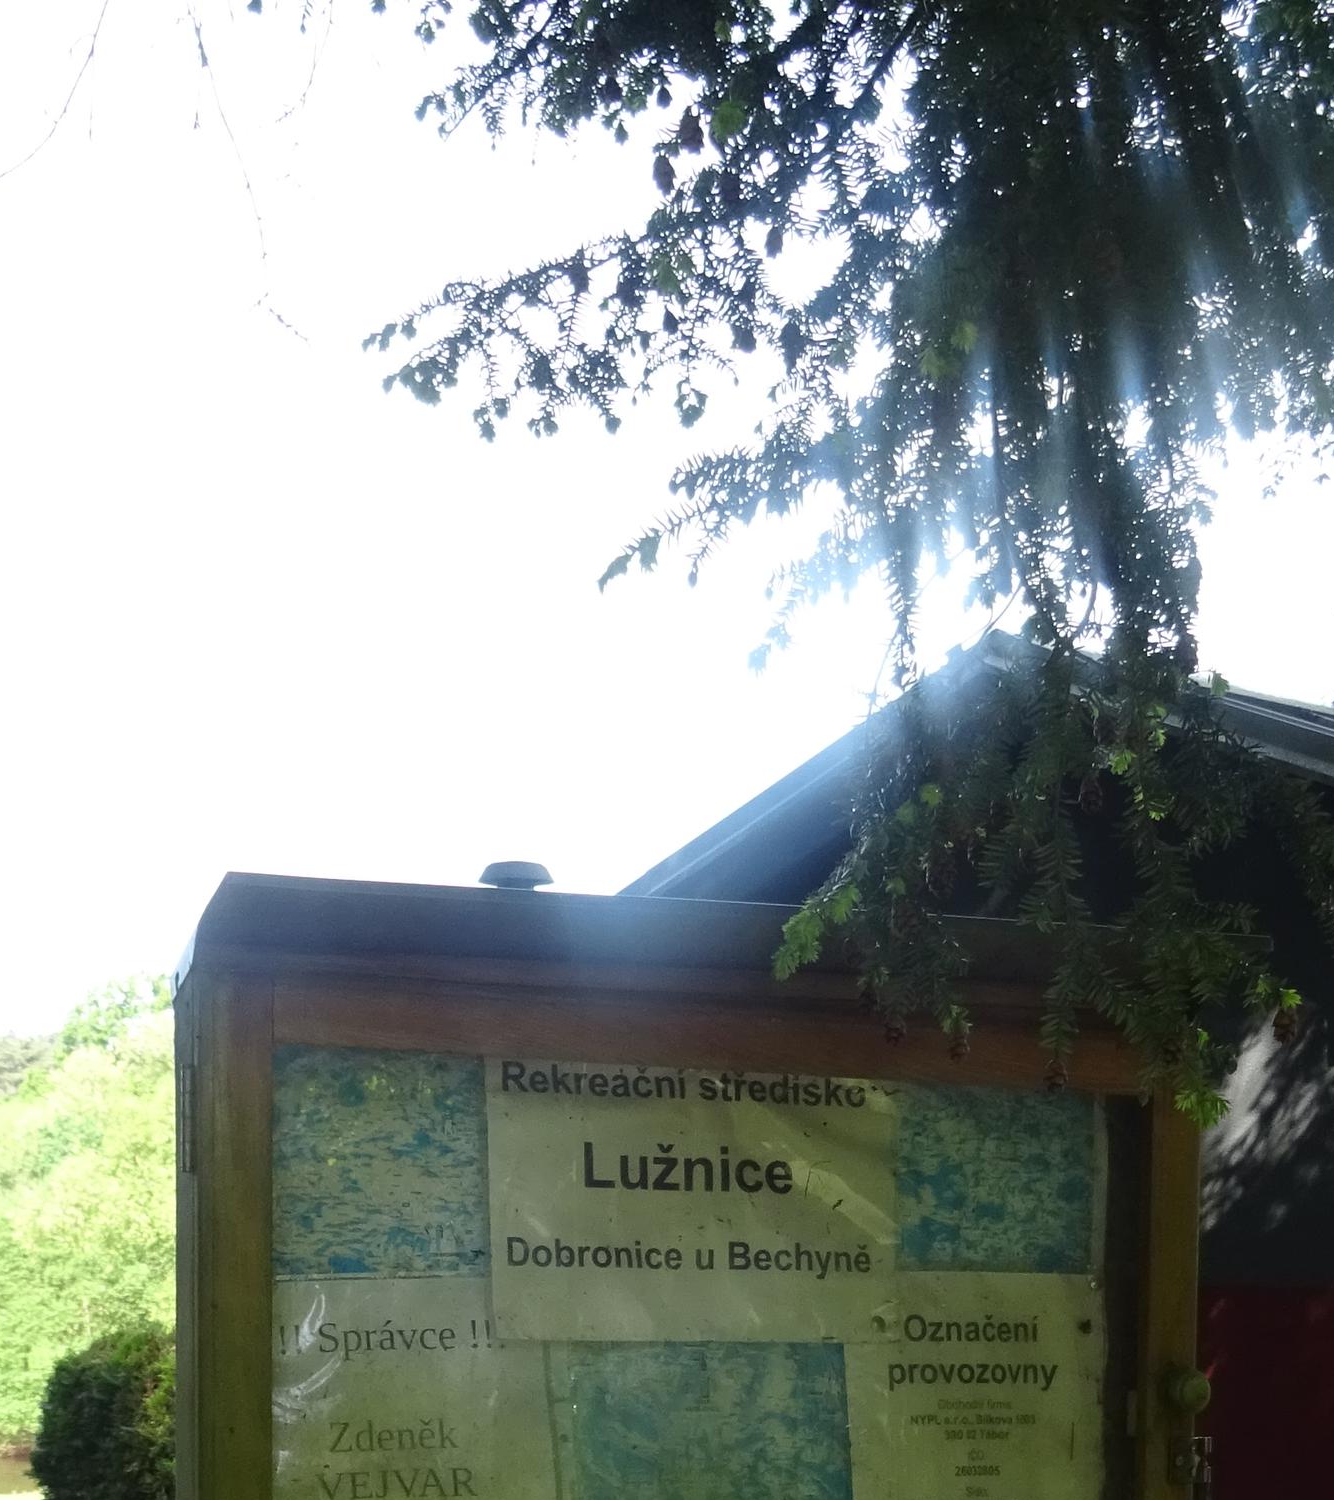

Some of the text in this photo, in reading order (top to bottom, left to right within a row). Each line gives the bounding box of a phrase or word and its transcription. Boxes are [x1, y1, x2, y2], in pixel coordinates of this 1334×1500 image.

[698, 1071, 866, 1108] středisko
[583, 1141, 793, 1194] Lužnice
[507, 1236, 871, 1280] Dobronice u Bechyně
[318, 1319, 456, 1361] Správce
[904, 1314, 1039, 1342] Označení
[888, 1363, 1059, 1392] provozovny
[328, 1417, 459, 1453] Zdeněk
[317, 1467, 478, 1500] VEJVAR
